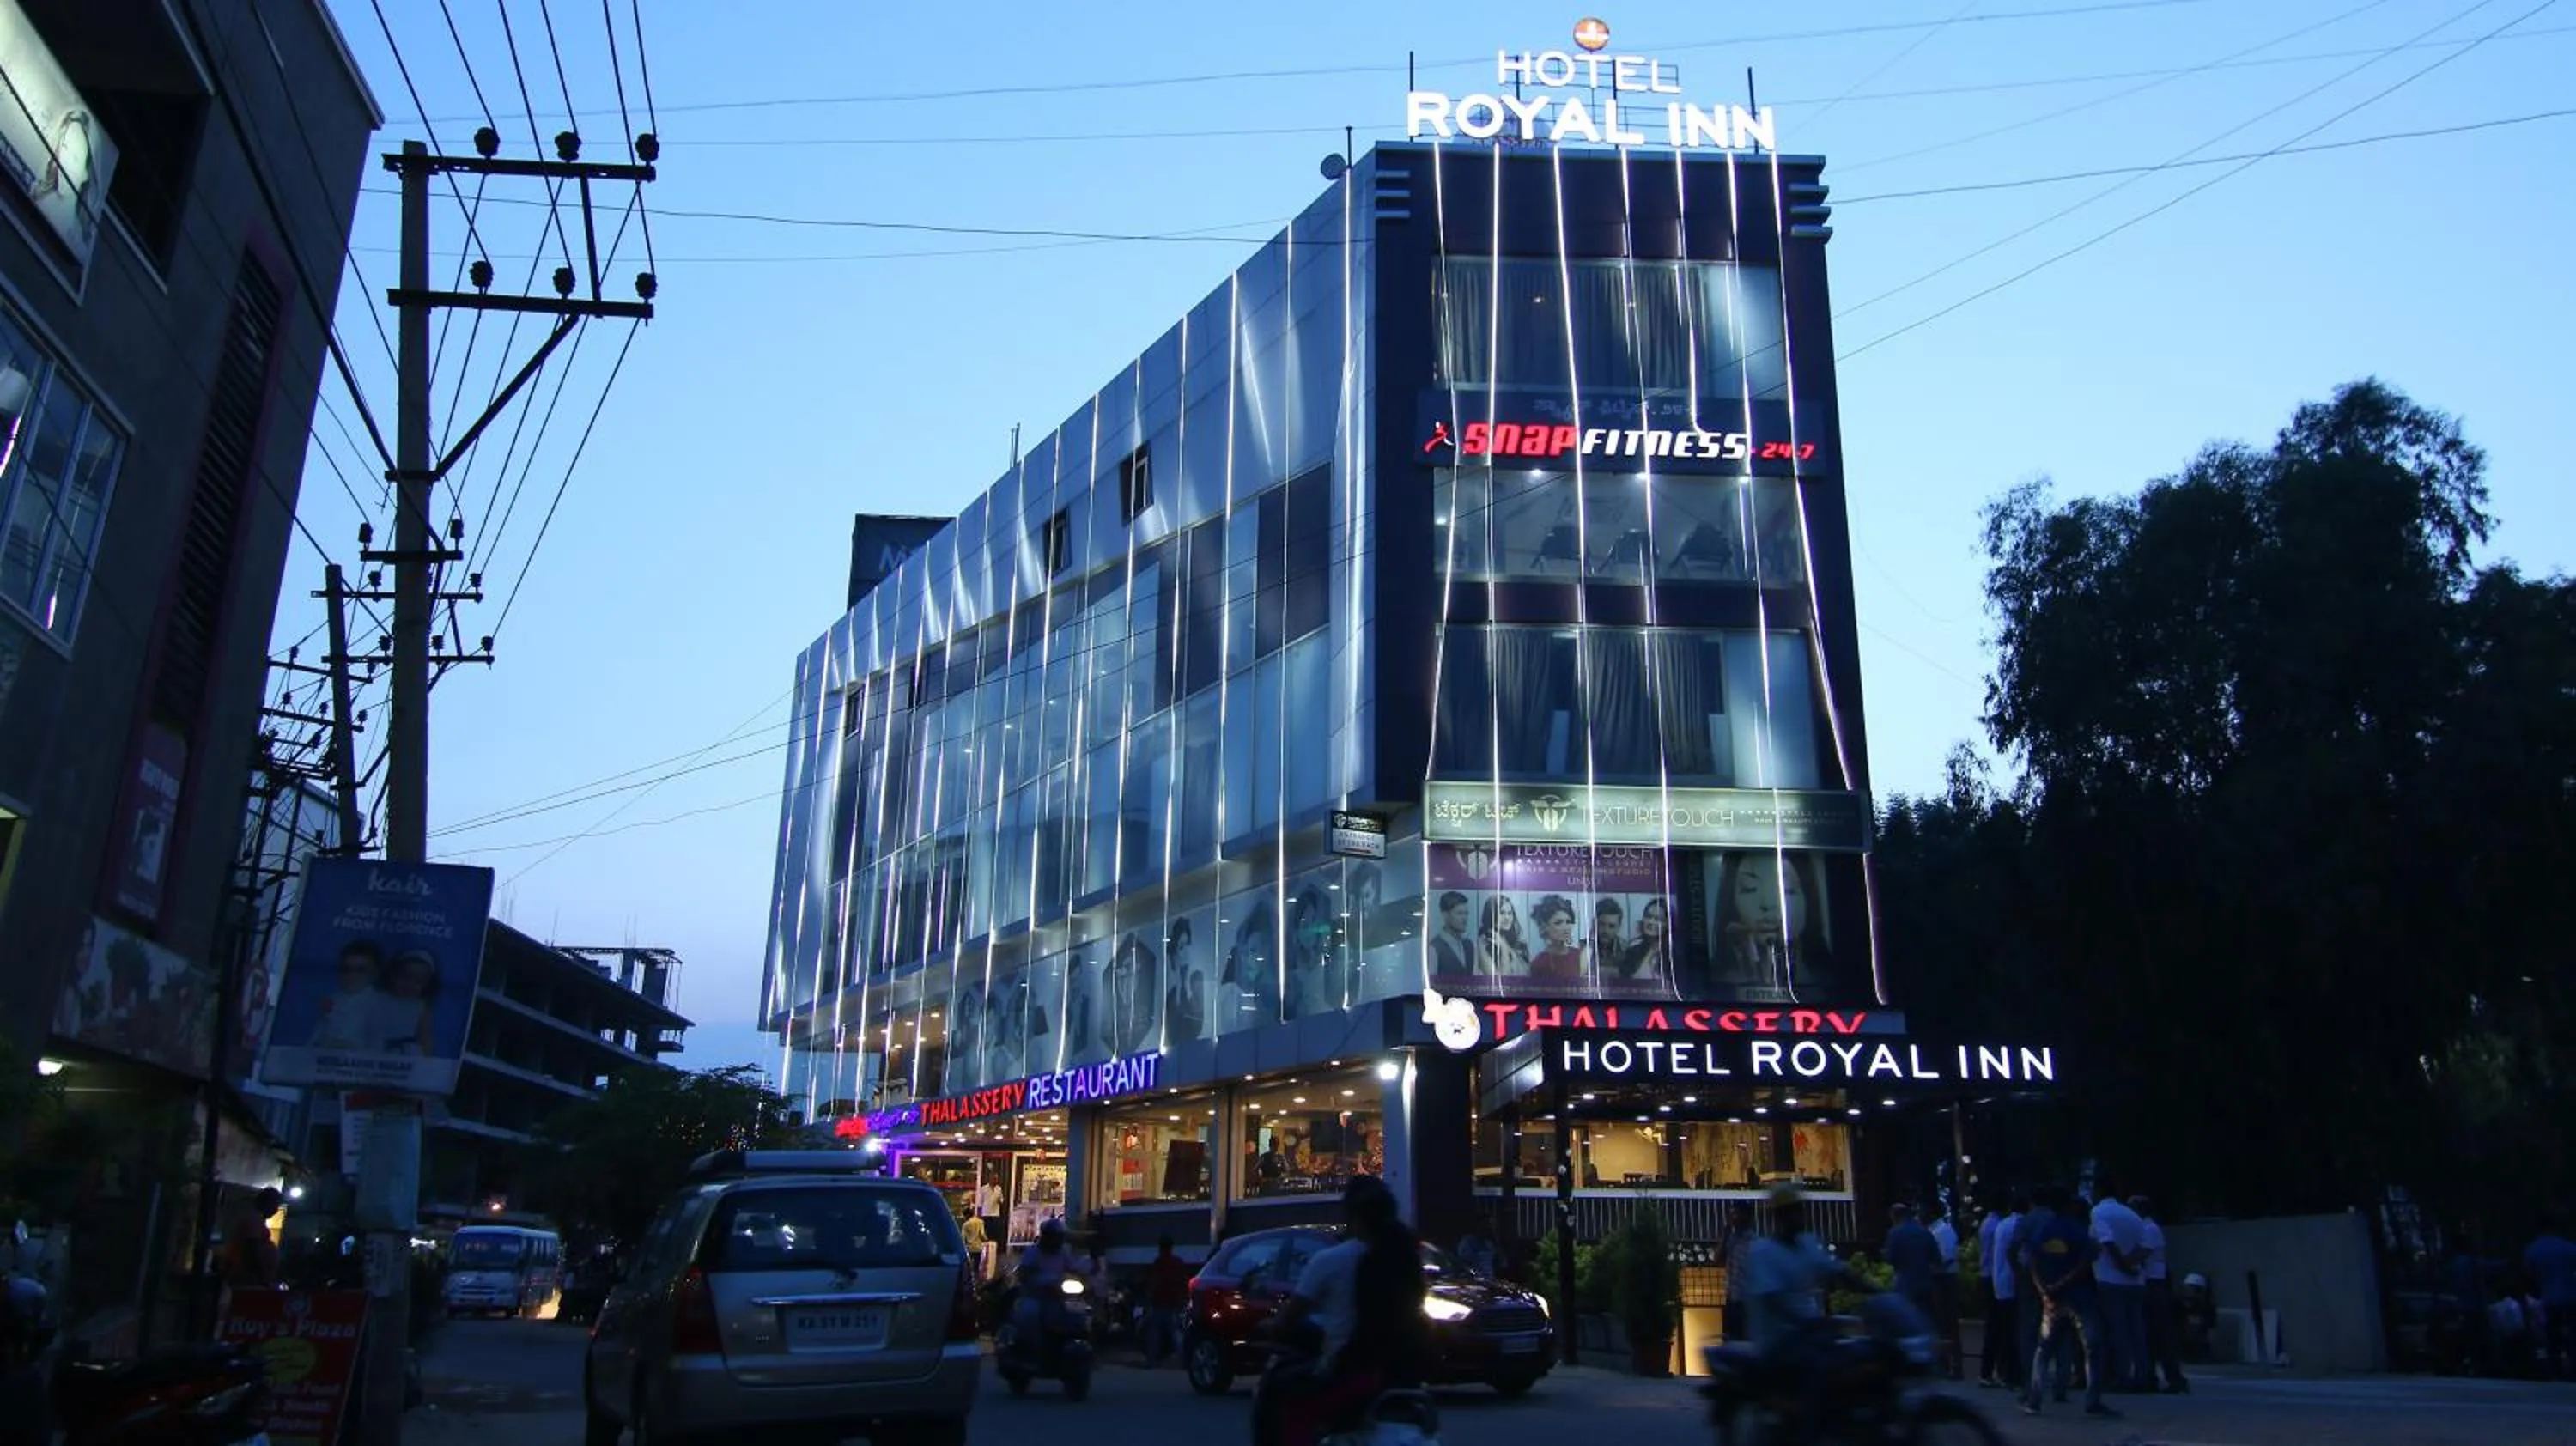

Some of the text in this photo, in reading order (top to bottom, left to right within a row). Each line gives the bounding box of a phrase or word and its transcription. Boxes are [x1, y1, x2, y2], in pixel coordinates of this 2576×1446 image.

[1498, 50, 1681, 94] HOTEL
[1407, 91, 1776, 151] ROYAL INN
[1581, 428, 1749, 459] FITNESS
[1517, 844, 1653, 860] TEXTUREOUCH
[1562, 1039, 2056, 1082] HOTEL ROYAL INN
[920, 1081, 1029, 1126] THALASSERY
[1029, 1052, 1161, 1109] RESTAURANT
[295, 1317, 356, 1338] Plaza
